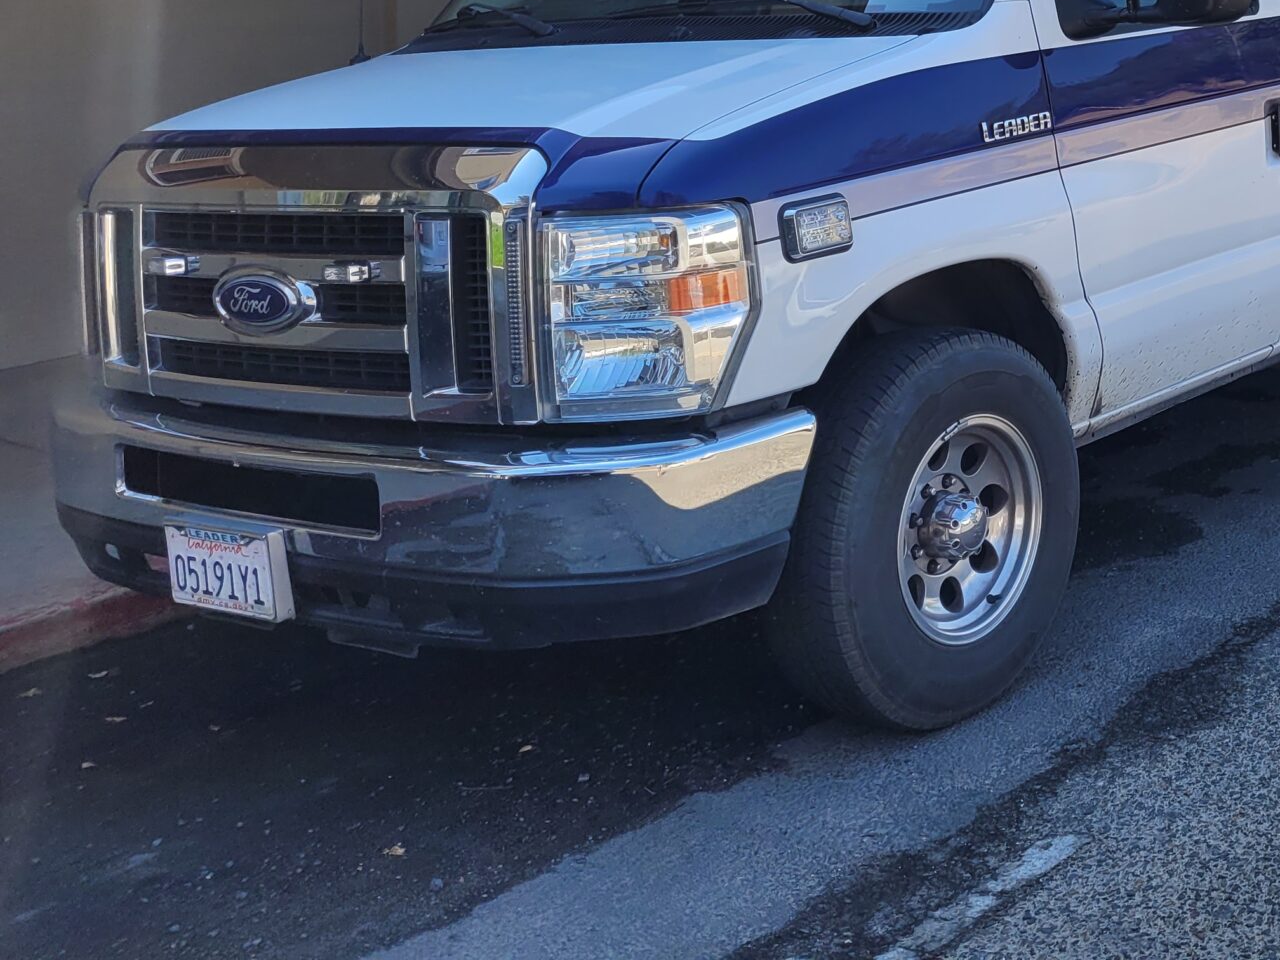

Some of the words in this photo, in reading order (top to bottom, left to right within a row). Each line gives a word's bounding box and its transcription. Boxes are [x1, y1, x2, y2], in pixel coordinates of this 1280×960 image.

[981, 111, 1052, 143] LEADER
[230, 285, 272, 314] Ford
[187, 538, 250, 558] California
[188, 528, 239, 545] LEADER
[175, 554, 265, 607] 05191Y1
